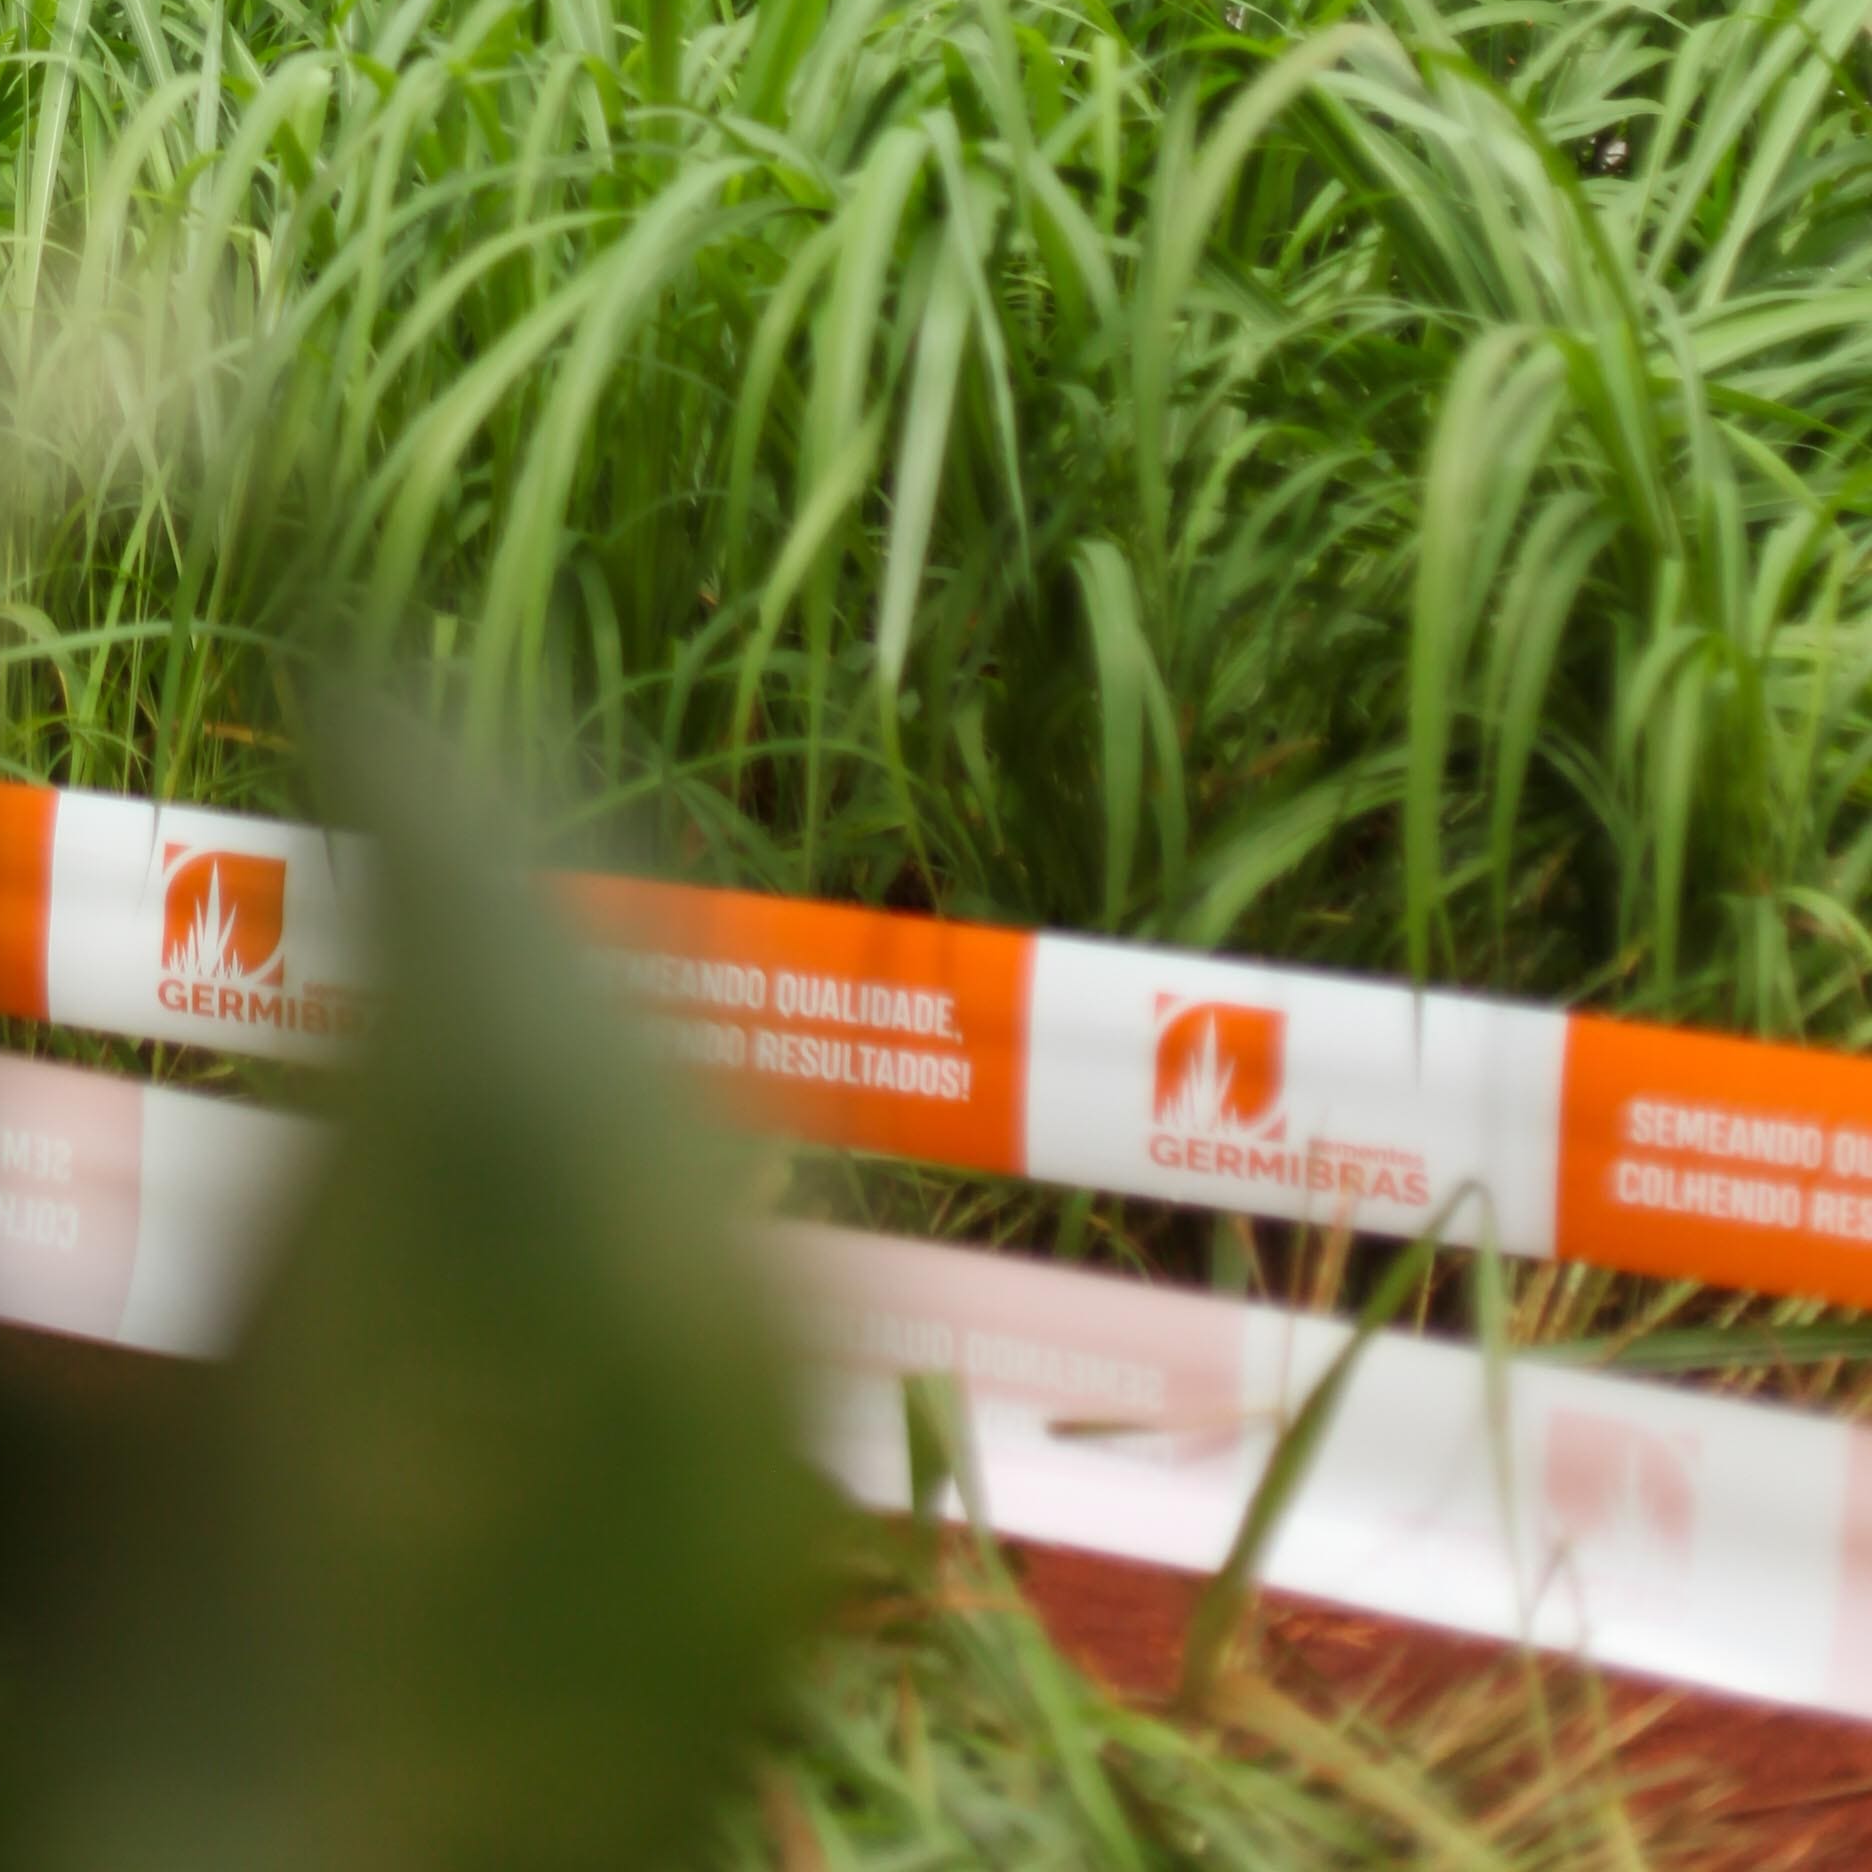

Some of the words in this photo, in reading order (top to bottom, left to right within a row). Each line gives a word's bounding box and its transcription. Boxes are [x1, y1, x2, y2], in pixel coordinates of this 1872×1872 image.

[775, 970, 964, 1046] QUALIDADE,
[754, 1026, 972, 1103] RESULTADOS!
[1148, 1132, 1430, 1207] GERMIBRAS
[1630, 1099, 1825, 1170] SEMEANDO
[1615, 1159, 1803, 1230] COLHENDO
